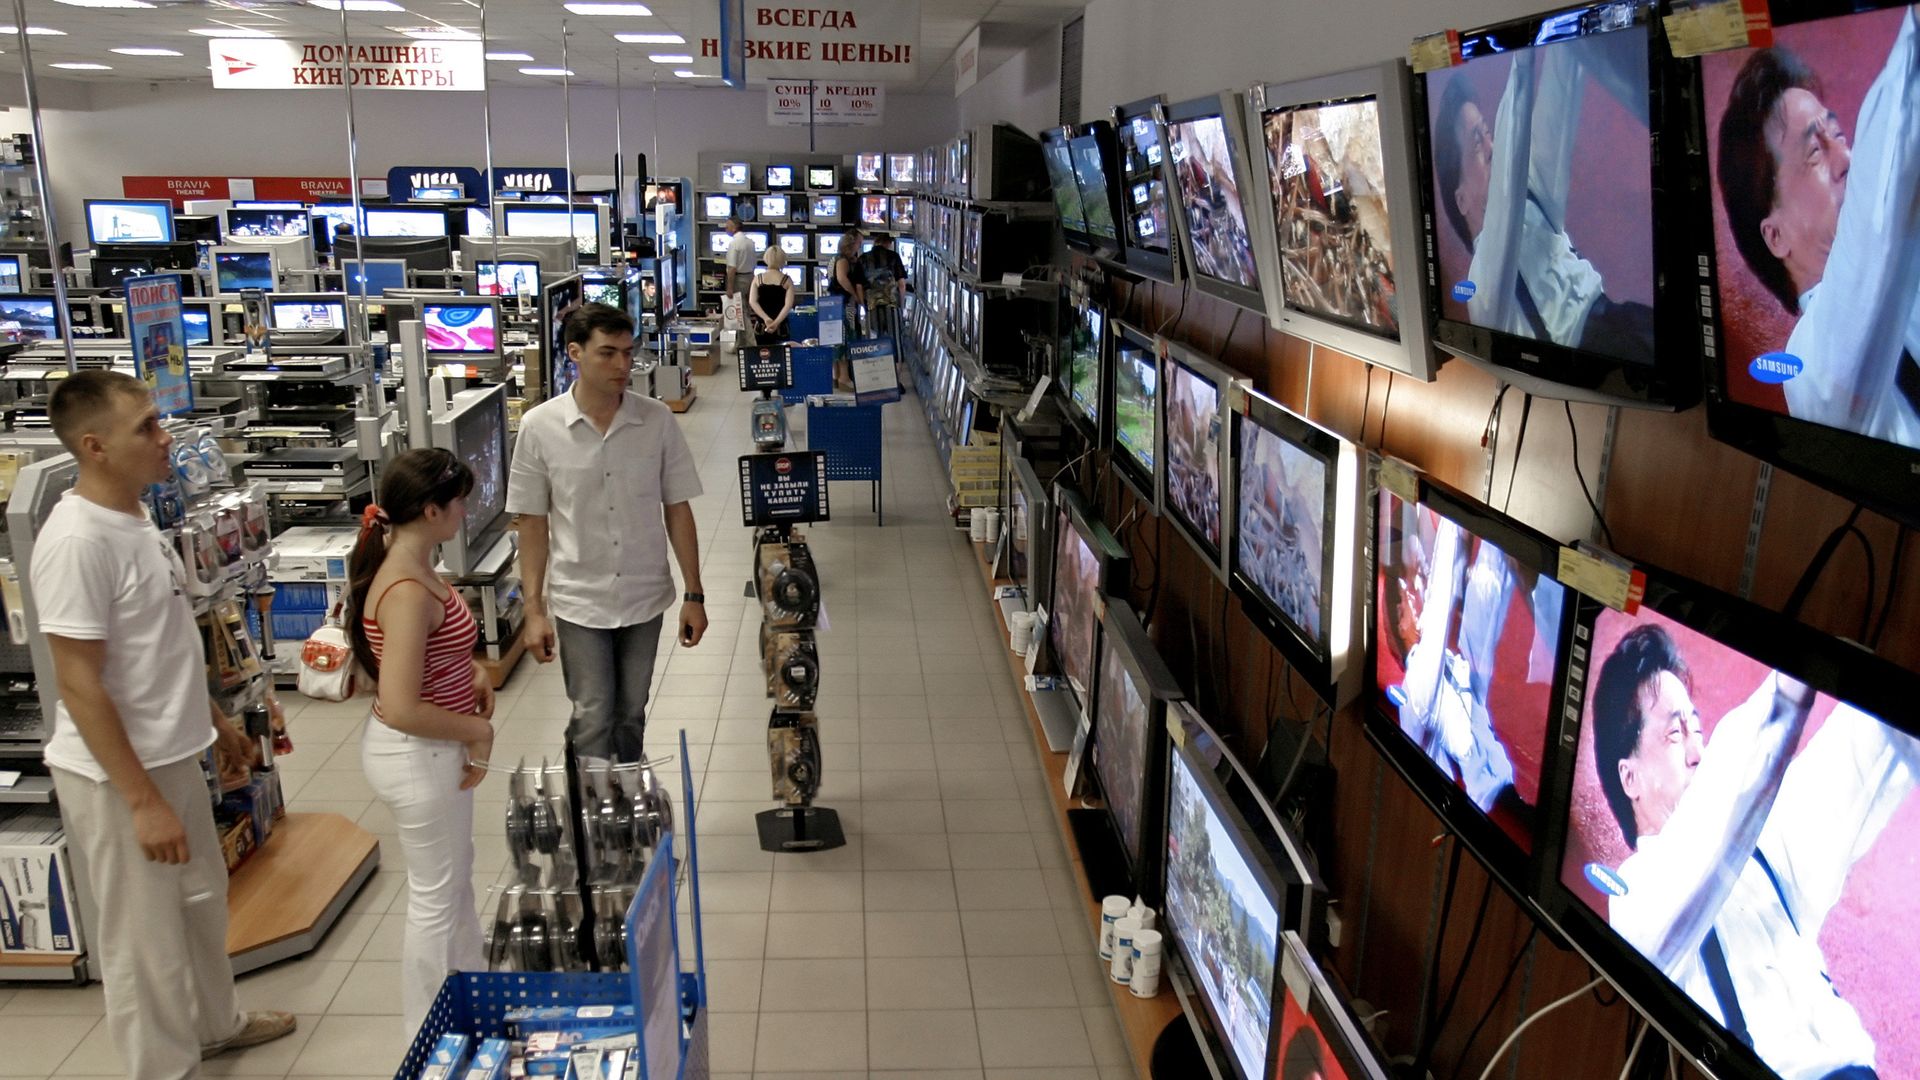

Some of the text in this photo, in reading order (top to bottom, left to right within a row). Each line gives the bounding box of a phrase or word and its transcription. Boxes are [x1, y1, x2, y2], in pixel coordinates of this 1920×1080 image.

[756, 8, 857, 32] ВСЕГДА
[301, 44, 444, 65] ДОМАШНИЕ
[701, 38, 911, 65] НЗКИЕ ЦЕНЫ!
[775, 85, 877, 97] СУПЕР КРЕДИТ
[778, 98, 801, 108] 10%
[851, 99, 873, 109] 10%
[167, 180, 211, 190] BRAVIA
[300, 181, 345, 191] BRAVIA
[129, 283, 179, 307] ПОИСК
[850, 344, 880, 355] ПОИСК
[1756, 357, 1800, 378] SAMSUNG
[773, 481, 809, 490] ЗАБЫЛИ
[763, 488, 806, 498] КУПИТЬ
[767, 496, 803, 505] КАБЕЛИ?
